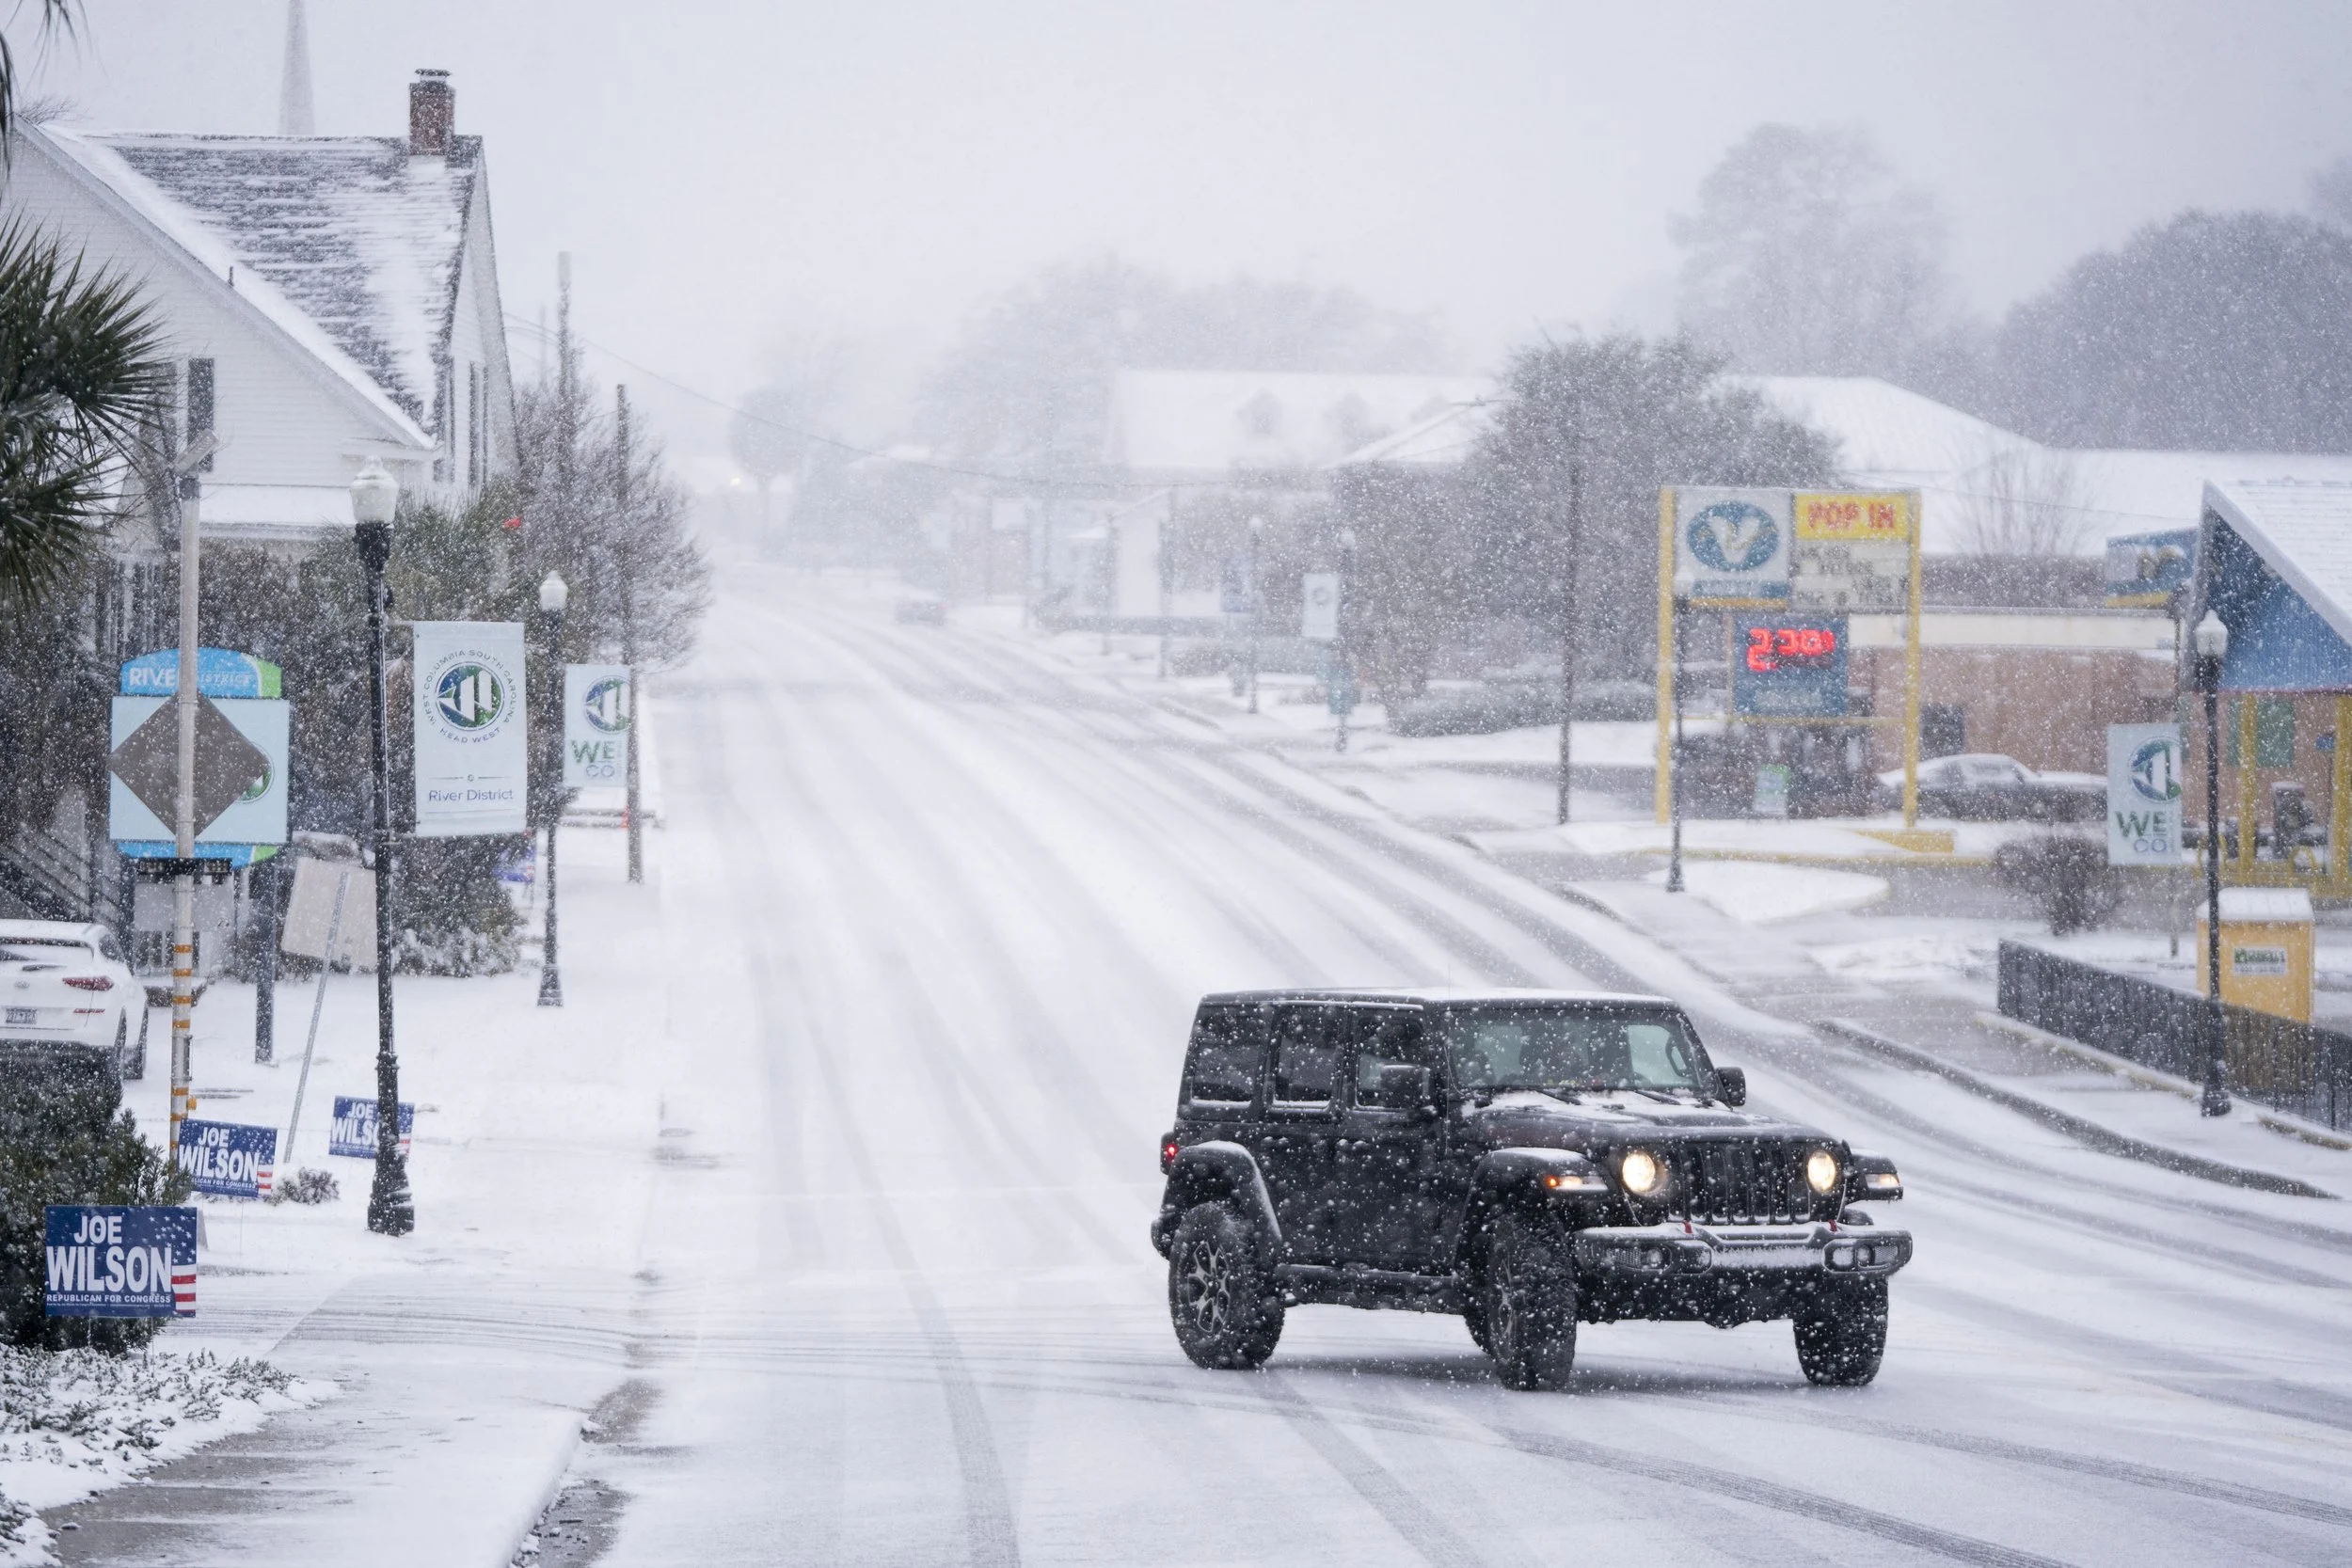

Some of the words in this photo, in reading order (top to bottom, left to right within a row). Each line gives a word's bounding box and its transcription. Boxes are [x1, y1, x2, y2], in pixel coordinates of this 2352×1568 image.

[129, 667, 179, 688] RIVE
[199, 671, 250, 687] ISTRICT
[423, 649, 466, 690] COLUMBIA
[469, 649, 503, 671] SOUTH
[503, 670, 517, 724] CAROLINA
[439, 727, 469, 744] HEAD
[472, 727, 501, 744] WEST
[571, 739, 615, 763] WE
[586, 765, 614, 778] CO
[428, 788, 464, 802] River
[467, 786, 514, 801] District
[2115, 811, 2166, 837] WE
[347, 1102, 374, 1119] JOE
[198, 1127, 230, 1148] JOE
[331, 1117, 380, 1147] WILS
[179, 1143, 260, 1181] WILSON
[73, 1215, 122, 1244] JOE
[46, 1245, 171, 1293] WILSON
[104, 1294, 122, 1303] FOR
[124, 1294, 171, 1303] CONGRESS
